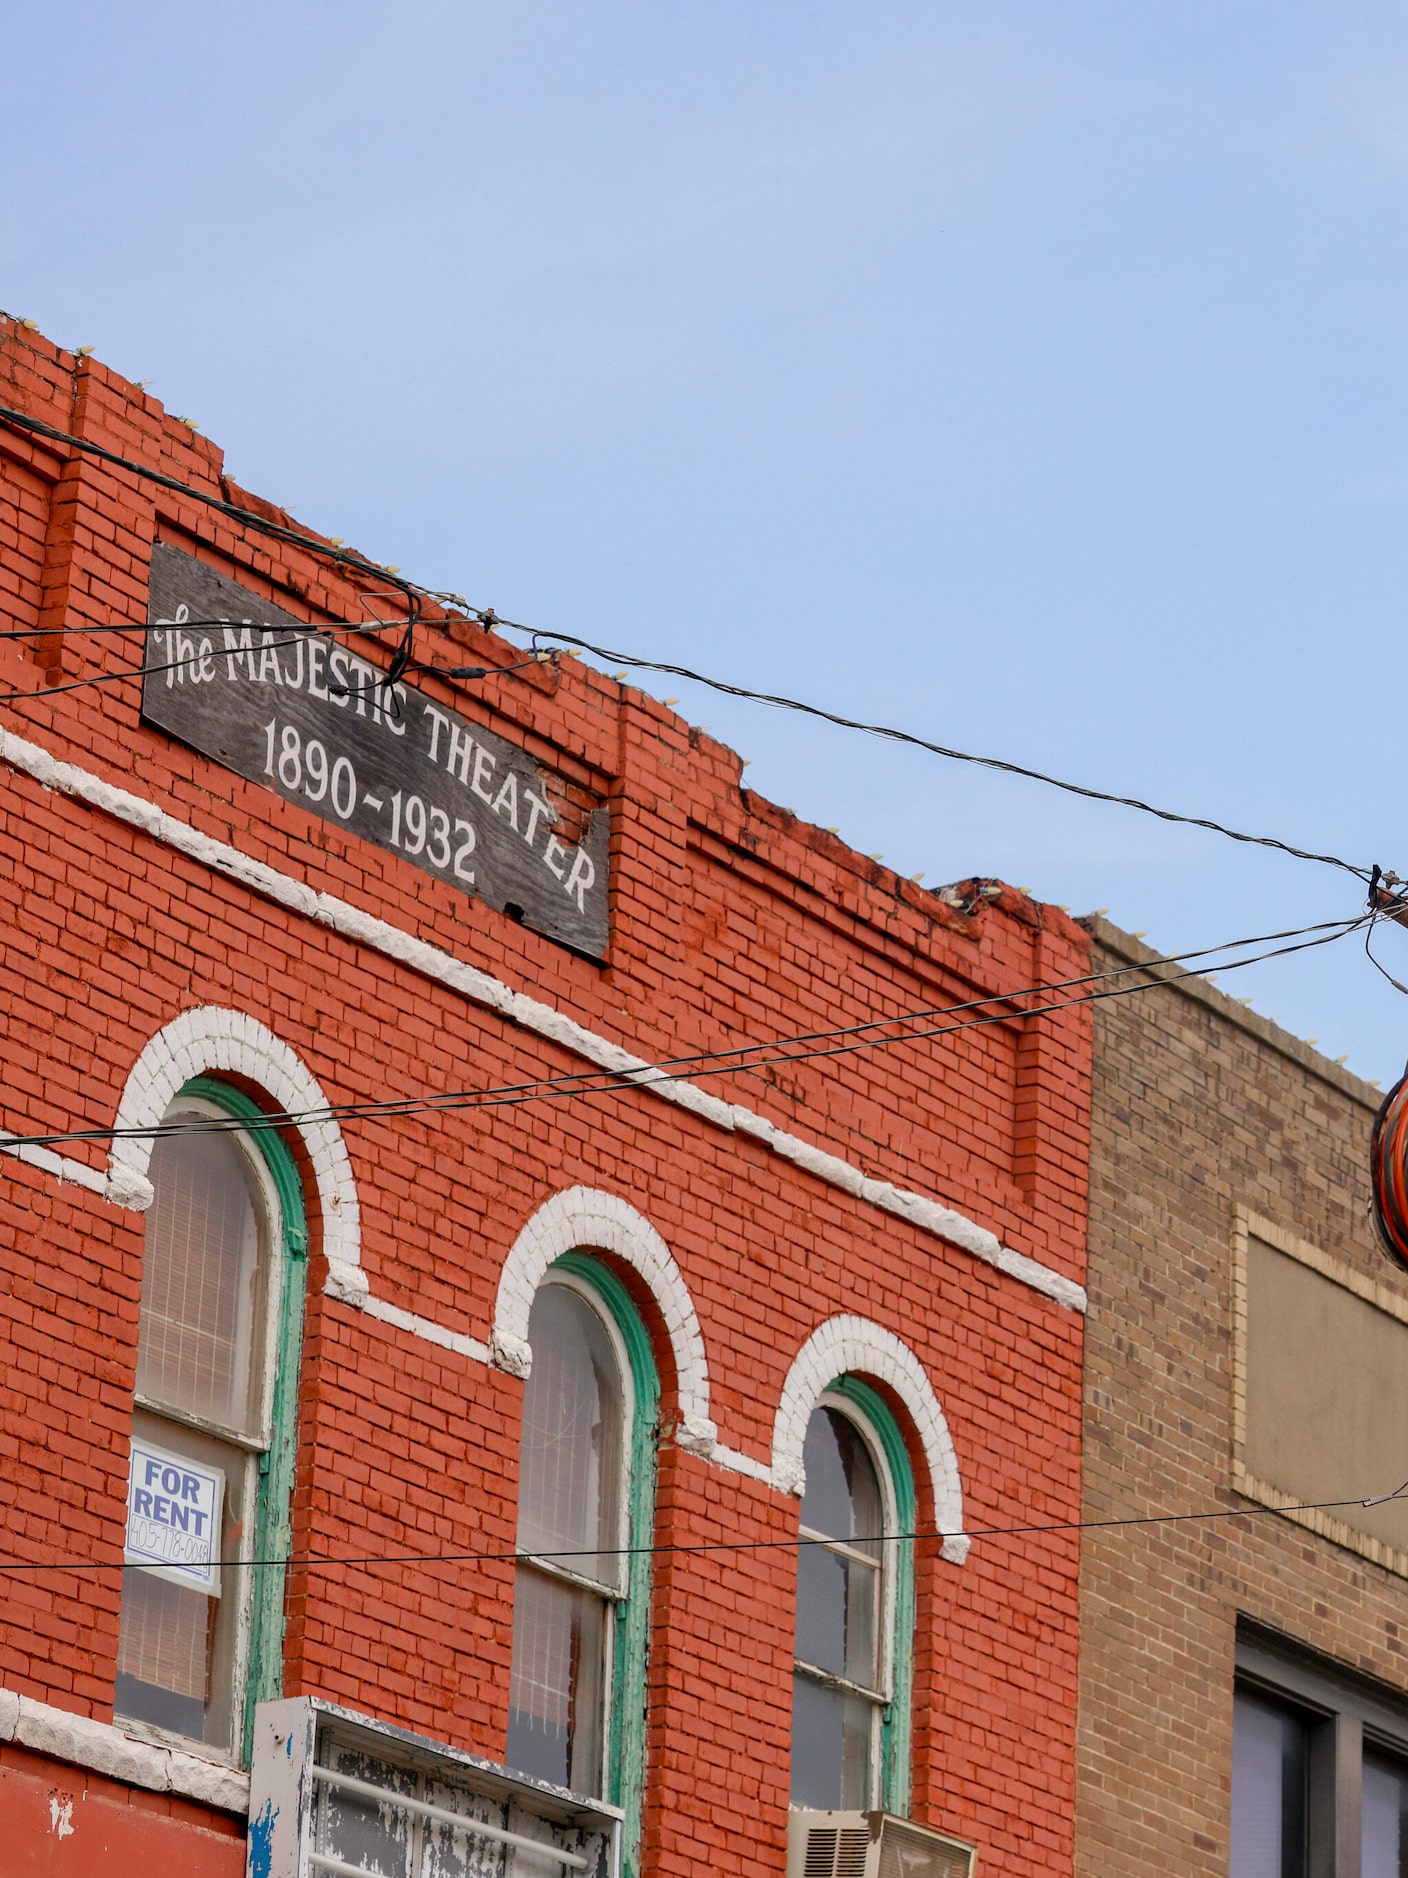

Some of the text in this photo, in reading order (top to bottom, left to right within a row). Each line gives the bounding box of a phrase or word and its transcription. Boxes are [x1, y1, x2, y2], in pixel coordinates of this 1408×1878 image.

[153, 603, 596, 916] The MAJESTIC THEATER
[145, 1460, 200, 1504] FOR
[134, 1488, 208, 1537] RENT
